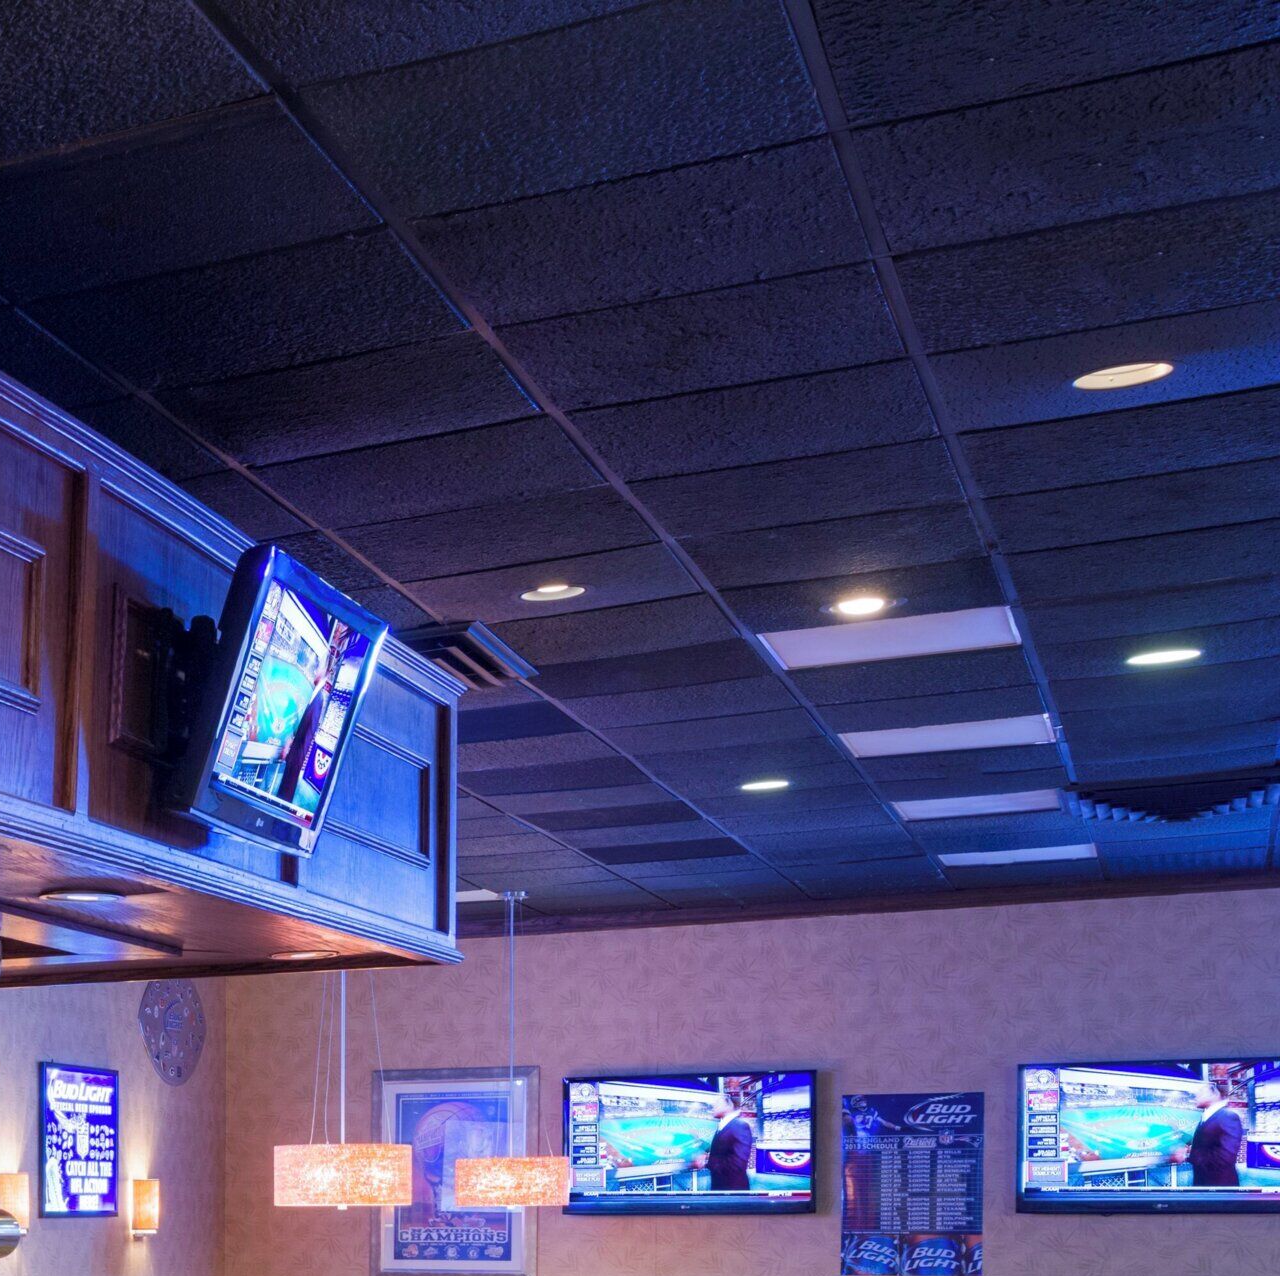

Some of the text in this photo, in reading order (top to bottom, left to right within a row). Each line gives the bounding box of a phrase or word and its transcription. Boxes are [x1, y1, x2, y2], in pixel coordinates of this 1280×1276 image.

[53, 1078, 114, 1104] BUD LIGHT
[925, 1103, 971, 1114] BUD
[916, 1114, 977, 1124] LIGHT
[66, 1160, 113, 1178] CATCH ALL THE
[399, 1231, 507, 1243] CHAMPIONS
[859, 1241, 898, 1257] BUD
[912, 1247, 956, 1259] BUD
[905, 1259, 960, 1271] LIGHT
